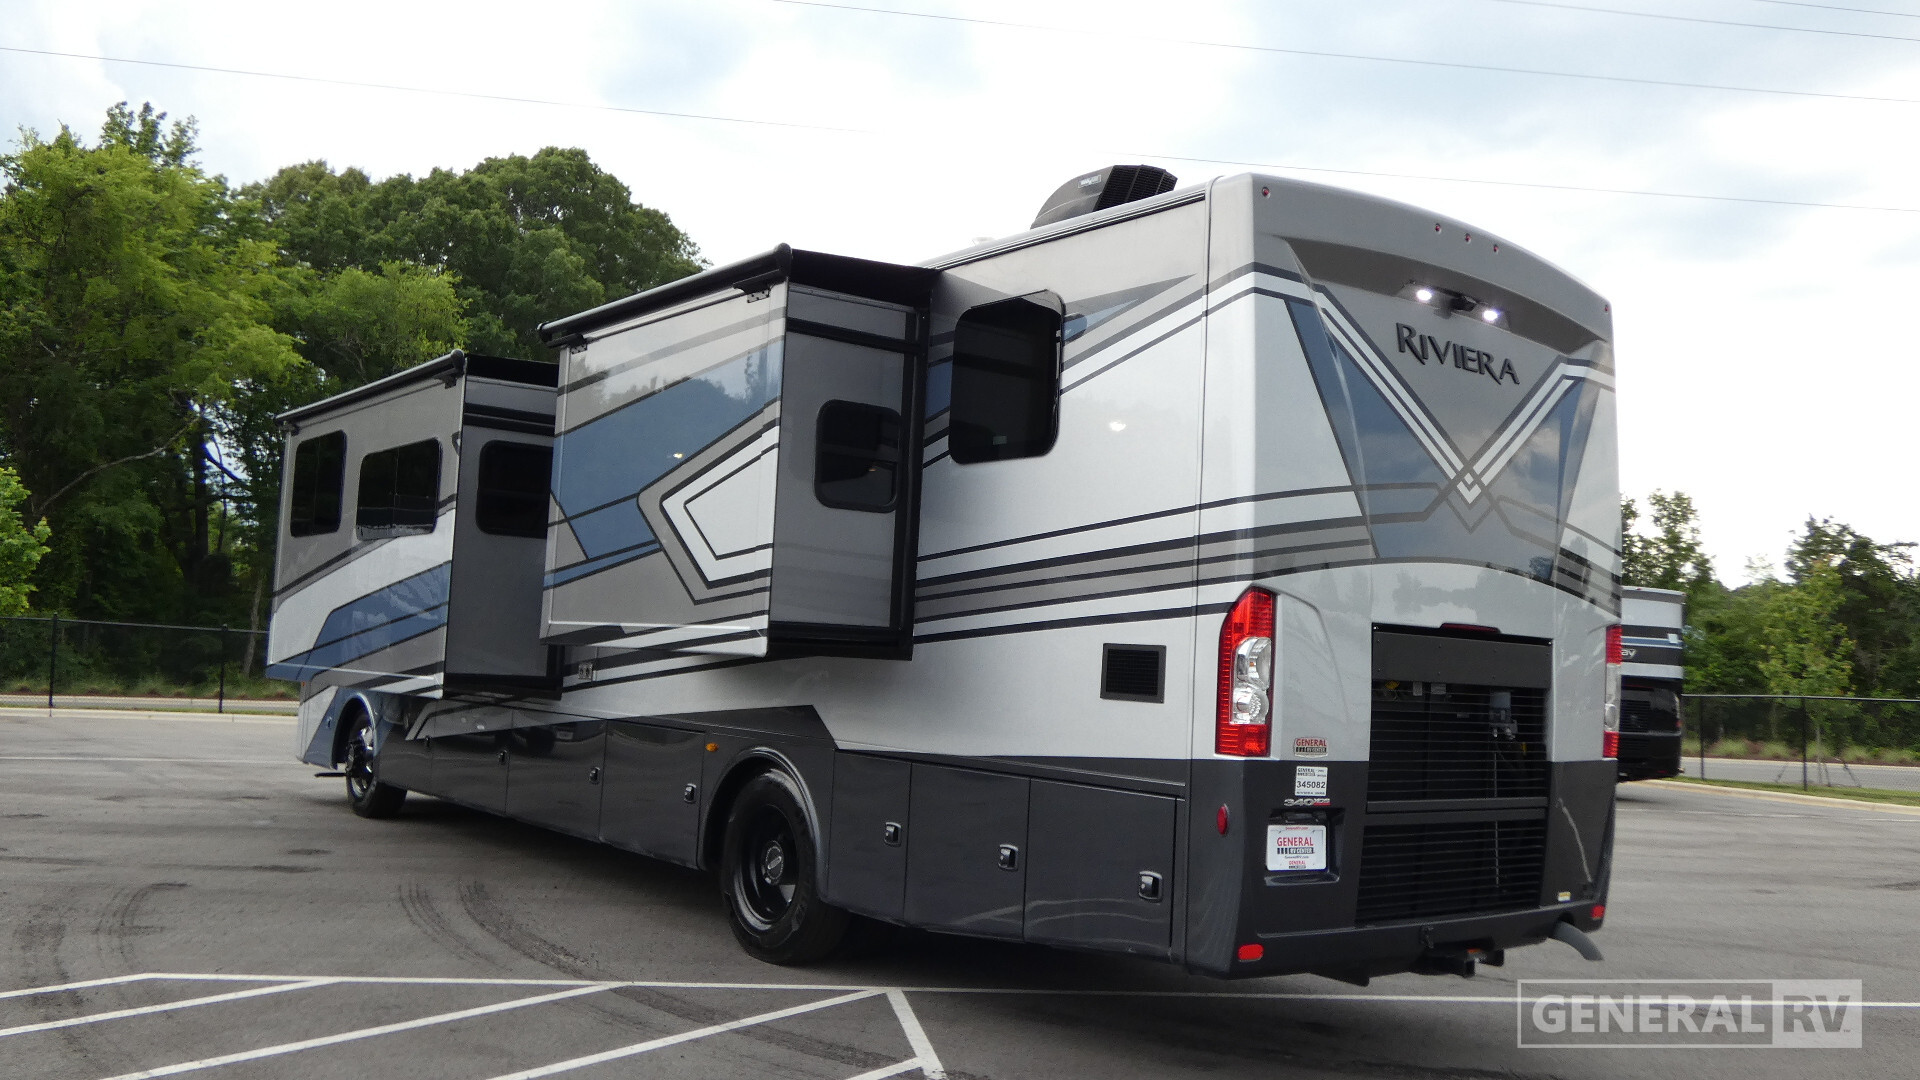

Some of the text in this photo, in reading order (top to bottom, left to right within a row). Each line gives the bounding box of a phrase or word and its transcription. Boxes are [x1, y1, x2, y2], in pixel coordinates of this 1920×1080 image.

[1396, 322, 1520, 385] RIVIERA
[1296, 738, 1327, 747] GENERAL
[1296, 780, 1326, 789] 345082
[1276, 836, 1314, 847] GENERAL
